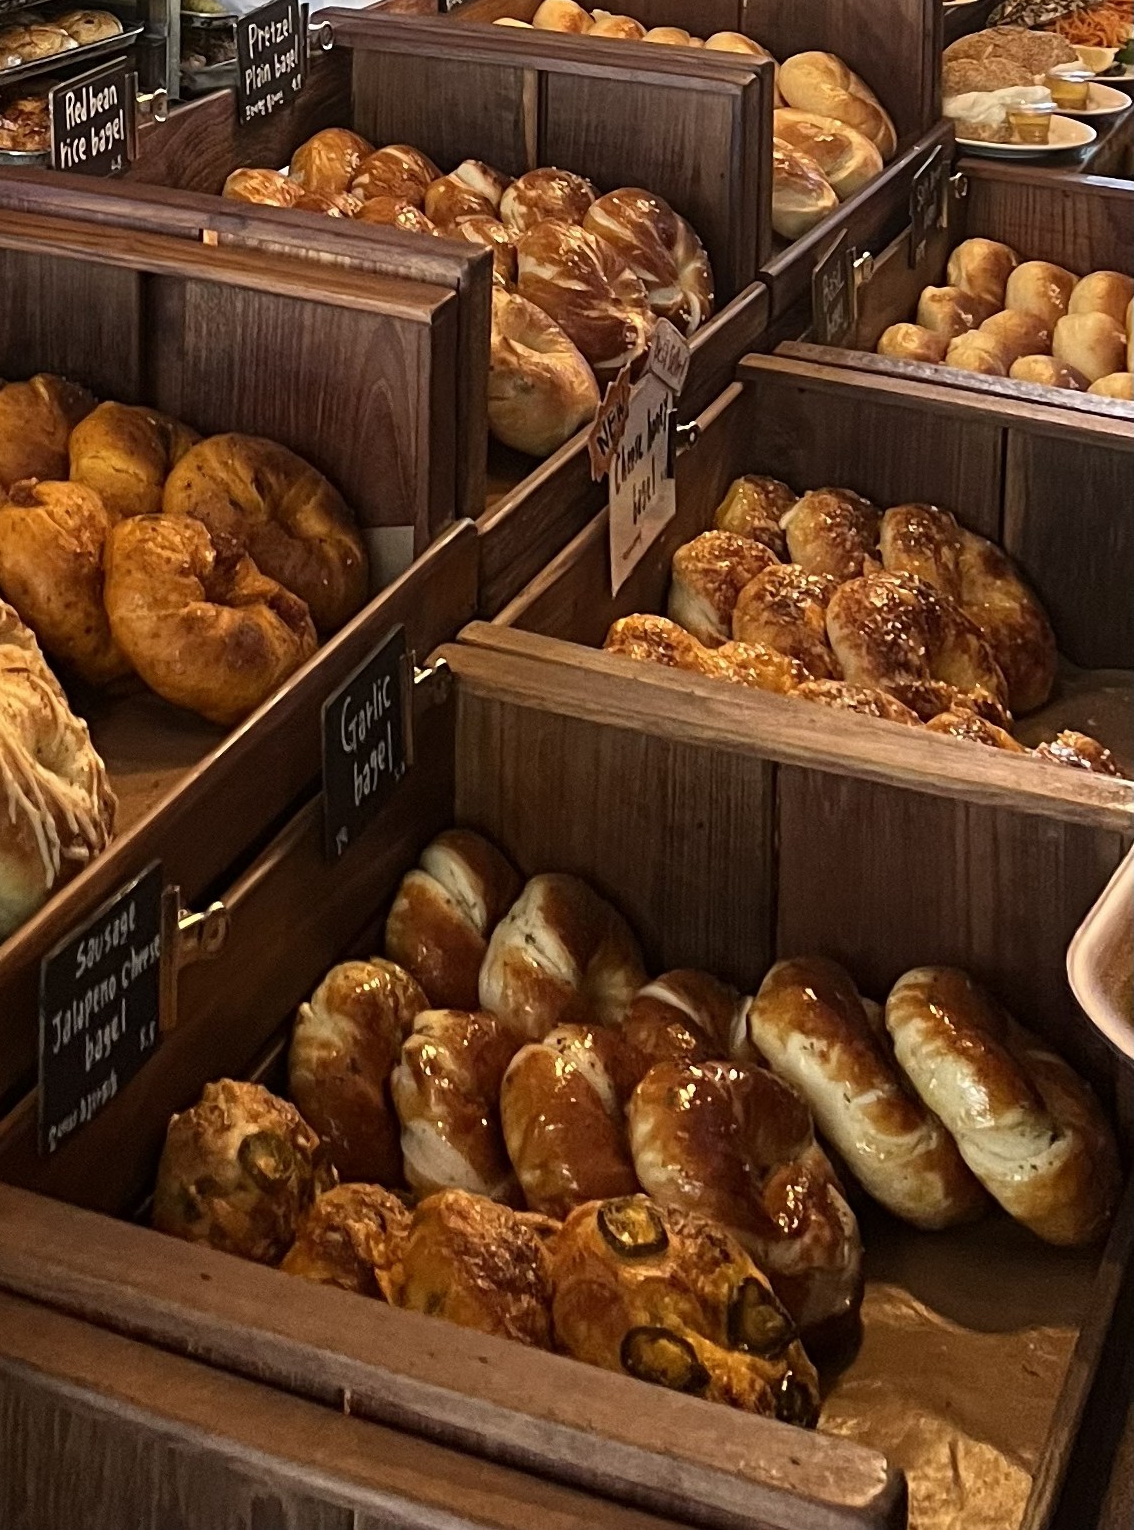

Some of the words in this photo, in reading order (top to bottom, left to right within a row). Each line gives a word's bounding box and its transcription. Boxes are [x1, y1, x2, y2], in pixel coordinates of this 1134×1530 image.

[245, 63, 272, 96] Plain
[273, 34, 299, 79] bagel
[248, 5, 293, 60] Pretzel
[60, 137, 87, 169] rice
[91, 108, 125, 157] bagel
[66, 86, 88, 131] Red
[88, 84, 118, 118] bean
[341, 675, 391, 754] Garlic
[353, 720, 393, 807] bagel
[75, 900, 136, 979] Sausage
[85, 997, 126, 1072] bagel
